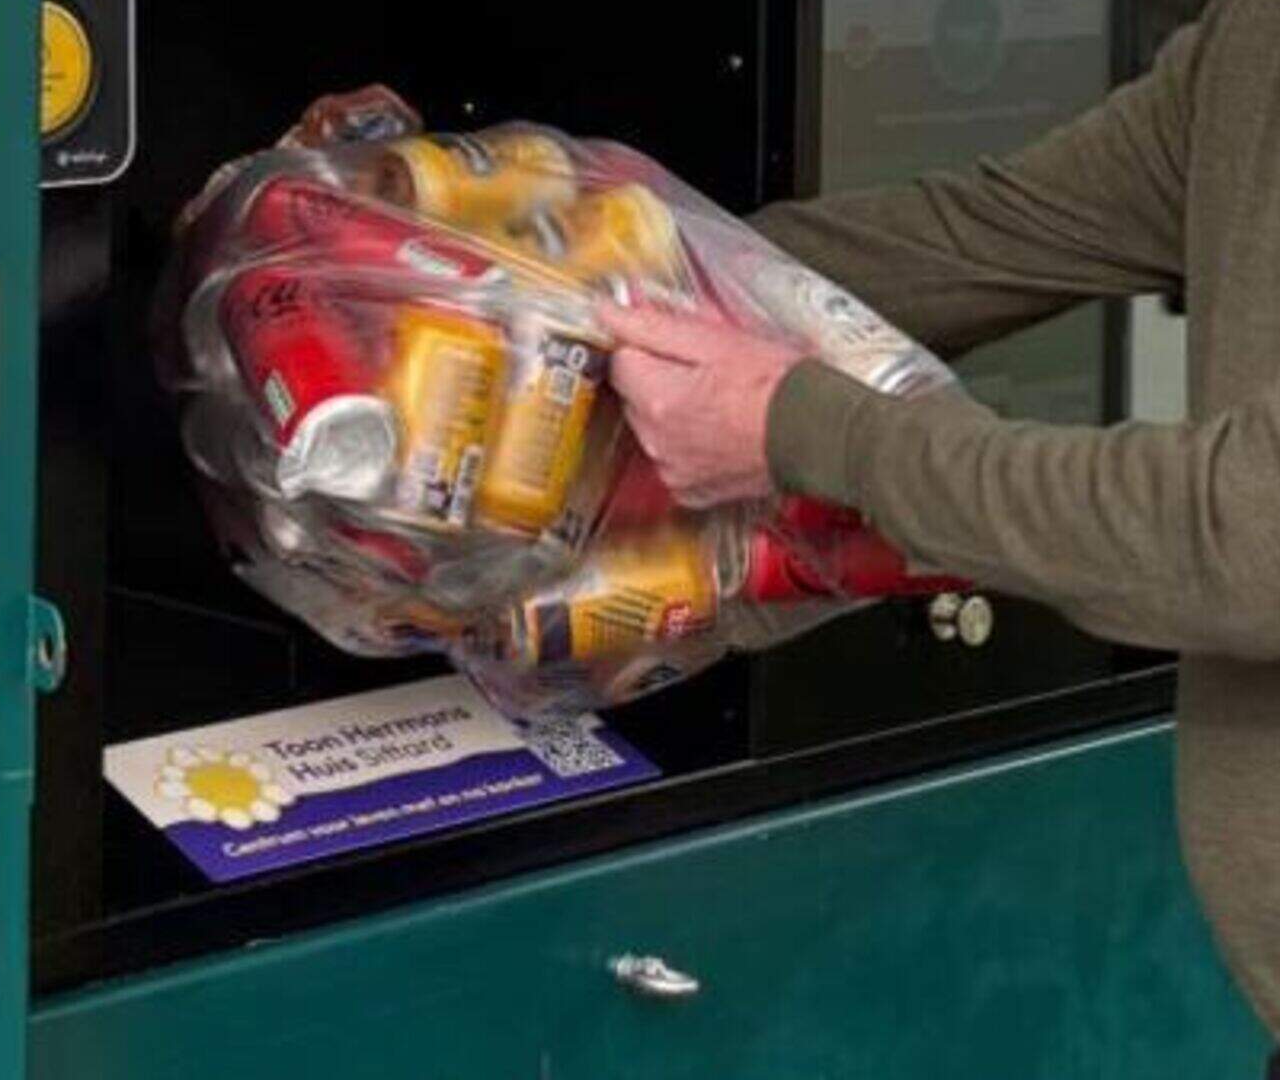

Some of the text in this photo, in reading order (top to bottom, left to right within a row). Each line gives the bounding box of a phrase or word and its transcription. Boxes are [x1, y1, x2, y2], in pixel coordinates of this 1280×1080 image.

[262, 706, 472, 760] Toon Hermans
[286, 734, 455, 783] Huis Sittard
